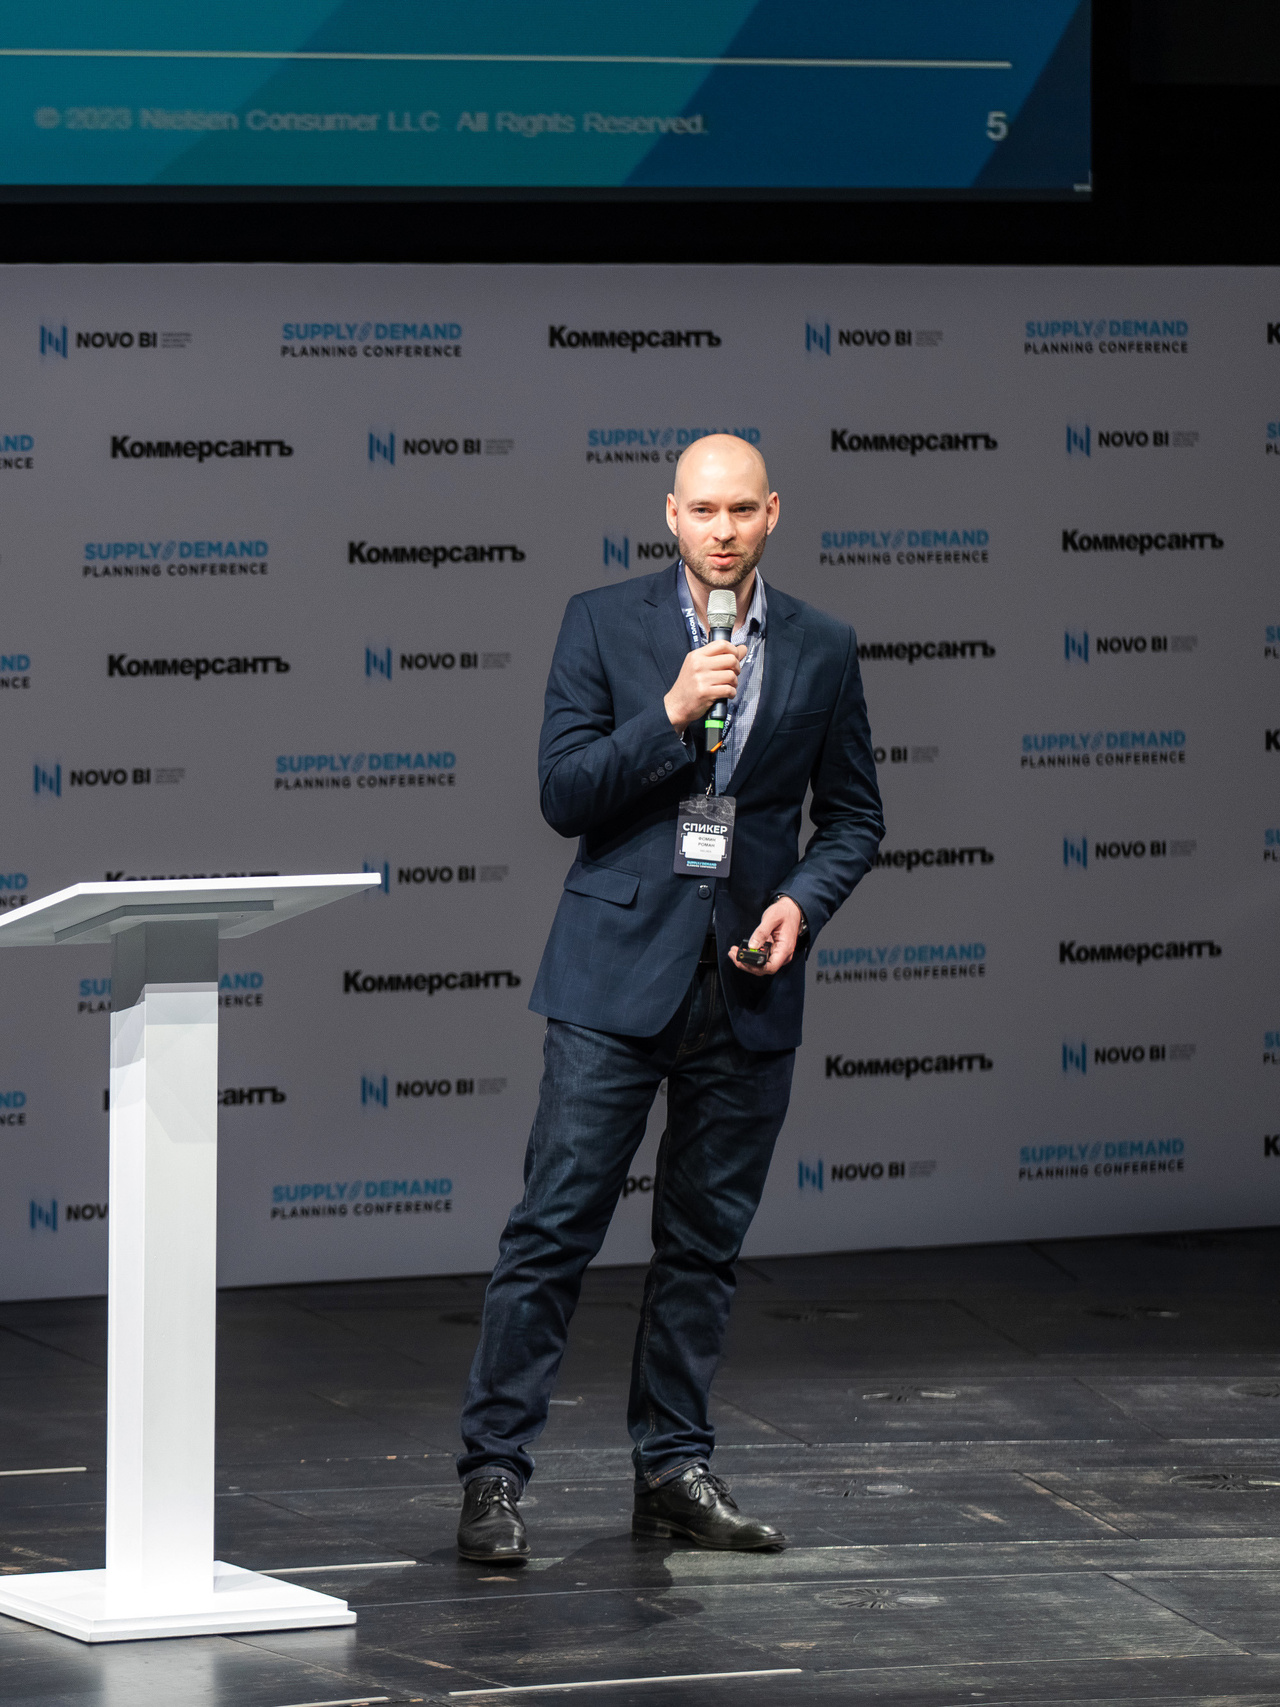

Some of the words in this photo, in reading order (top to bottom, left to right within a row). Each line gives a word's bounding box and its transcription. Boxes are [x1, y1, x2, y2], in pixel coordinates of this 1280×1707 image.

[245, 109, 381, 132] Consumer
[387, 109, 441, 132] LLC
[455, 110, 490, 133] All
[494, 110, 576, 138] Rights
[582, 111, 708, 135] Reserved.
[985, 110, 1009, 142] 5
[282, 322, 359, 341] SUPPLY
[373, 322, 463, 341] DEMAND
[547, 324, 723, 354] Коммерсантъ
[837, 328, 892, 348] NOVO
[894, 329, 913, 347] BI
[1025, 319, 1095, 339] SUPPLY
[1107, 319, 1189, 338] DEMAND
[75, 330, 135, 350] NOVO
[137, 330, 158, 349] BI
[280, 344, 358, 358] PLANNING
[362, 344, 462, 358] CONFERENCE
[402, 437, 460, 457] NOVO
[462, 437, 482, 456] BI
[587, 428, 657, 448] SUPPLY
[829, 427, 999, 458] Коммерсантъ
[1097, 429, 1150, 449] NOVO
[1151, 430, 1170, 448] BI
[109, 434, 295, 465] Коммерсантъ
[585, 449, 661, 465] PLANNING
[820, 530, 892, 550] SUPPLY
[905, 528, 990, 549] DEMAND
[1060, 528, 1226, 557] Коммерсантъ
[83, 541, 163, 562] SUPPLY
[177, 539, 270, 560] DEMAND
[346, 539, 527, 570] Коммерсантъ
[637, 541, 680, 560] NOV
[399, 651, 457, 671] NOVO
[459, 651, 479, 670] BI
[857, 640, 997, 664] ммерсантъ
[106, 652, 292, 682] Коммерсантъ
[1021, 732, 1092, 753] SUPPLY
[1104, 729, 1187, 750] DEMAND
[275, 754, 353, 774] SUPPLY
[367, 750, 457, 772] DEMAND
[891, 746, 908, 763] BI
[68, 767, 129, 788] NOVO
[131, 767, 152, 786] BI
[682, 822, 728, 835] СПИКЕР
[1094, 840, 1147, 860] NOVO
[1149, 839, 1168, 858] BI
[397, 865, 455, 885] NOVO
[456, 865, 477, 884] BI
[1058, 939, 1223, 967] Коммерсантъ
[342, 969, 523, 998] Коммерсантъ
[824, 1052, 995, 1081] Коммерсантъ
[395, 1078, 453, 1099] NOVO
[455, 1077, 475, 1097] BI
[830, 1161, 885, 1182] NOVO
[887, 1161, 906, 1180] BI
